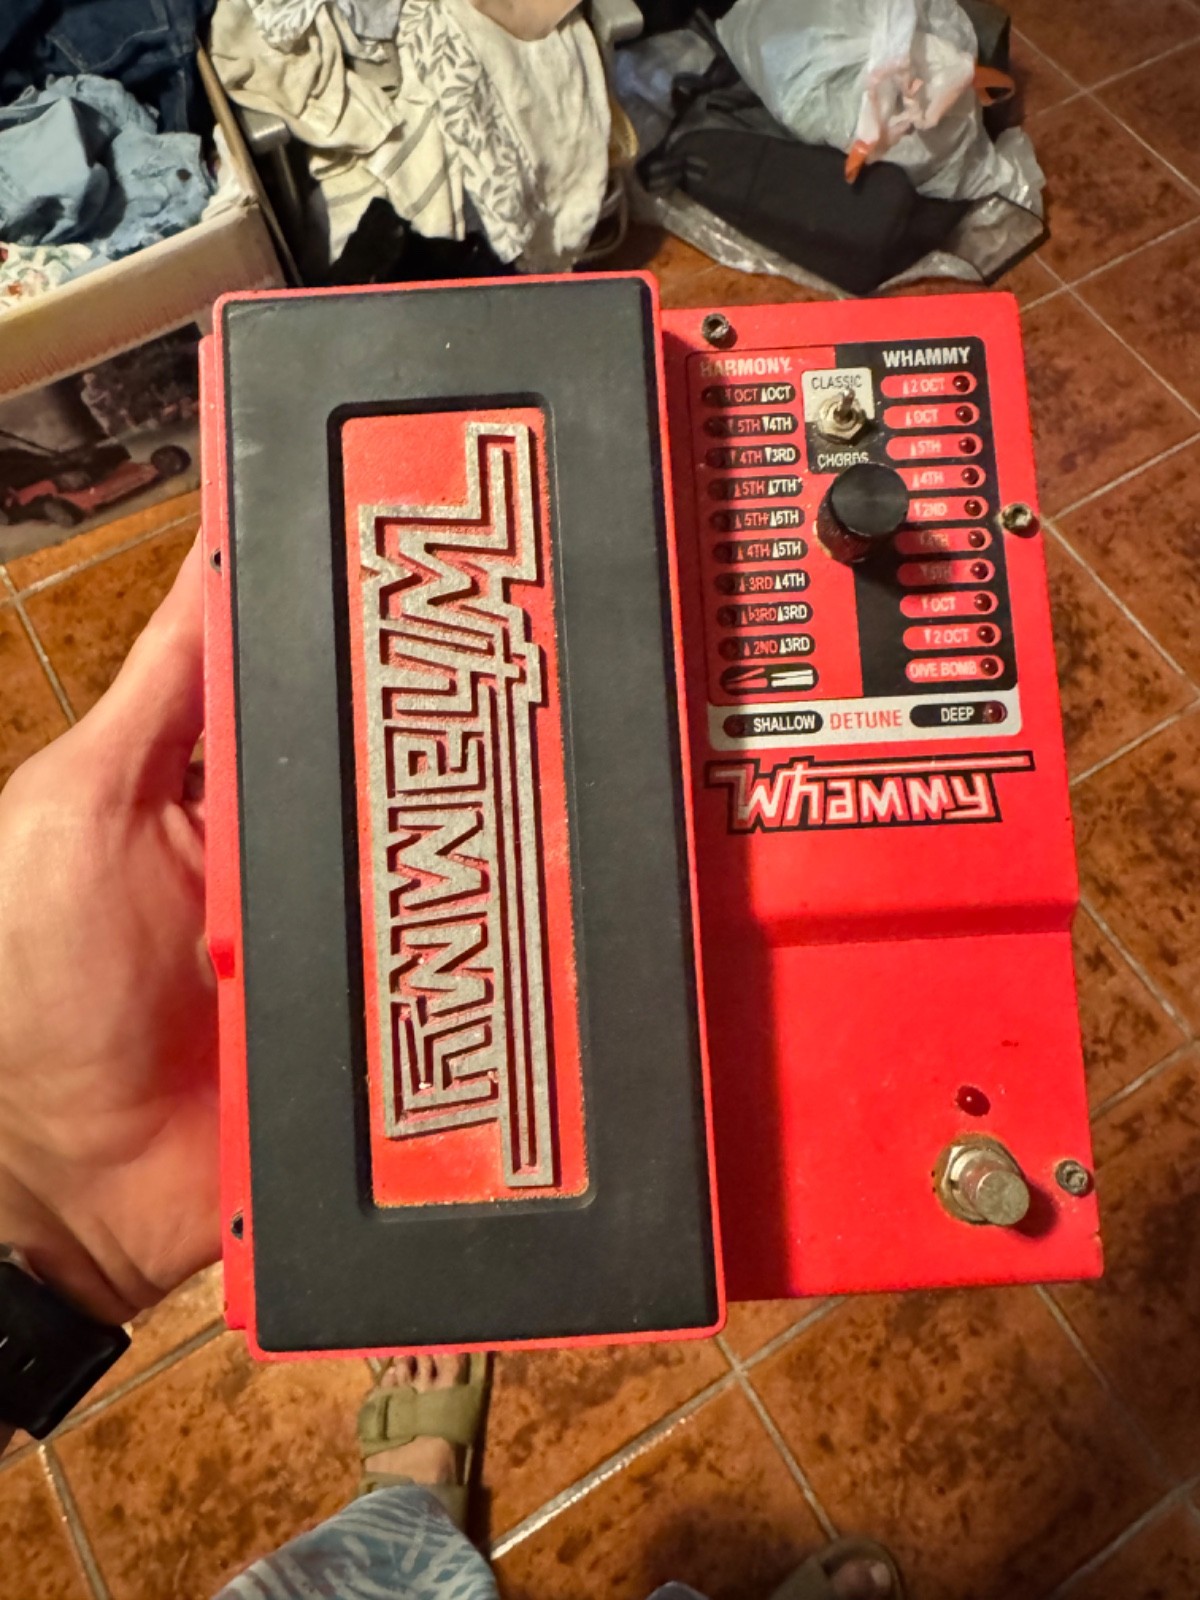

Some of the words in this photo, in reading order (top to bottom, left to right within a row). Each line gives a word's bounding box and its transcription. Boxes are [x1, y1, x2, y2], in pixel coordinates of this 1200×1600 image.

[882, 346, 971, 368] WHAMMY
[700, 357, 793, 377] HARMONY
[811, 374, 863, 390] CLASSIC
[911, 379, 918, 393] 2
[920, 377, 946, 393] OCT
[734, 388, 758, 402] OCT
[767, 385, 792, 401] OCT
[737, 419, 760, 433] 5TH
[769, 416, 793, 432] 4TH
[913, 408, 938, 424] OCT
[918, 439, 942, 454] 5TH
[740, 450, 763, 464] 4TH
[772, 447, 796, 462] 3RD
[817, 452, 870, 469] CHORDS
[920, 470, 944, 485] 4TH
[742, 480, 766, 495] 5TH
[774, 478, 798, 493] 7TH
[745, 511, 769, 527] 5TH
[776, 509, 799, 524] 5TH
[922, 502, 948, 517] 2ND
[747, 543, 771, 558] 4TH
[778, 541, 802, 556] 5TH
[749, 576, 774, 591] 3RD
[781, 572, 805, 588] 4TH
[783, 604, 808, 620] 3RD
[931, 596, 956, 612] OCT
[933, 628, 940, 644] 2
[943, 627, 970, 643] OCT
[753, 639, 779, 655] 2ND
[785, 637, 810, 653] 3RD
[940, 660, 978, 676] BOMB
[753, 714, 816, 733] SHALLOW
[830, 709, 903, 731] DETUNE
[940, 706, 975, 723] DEEP
